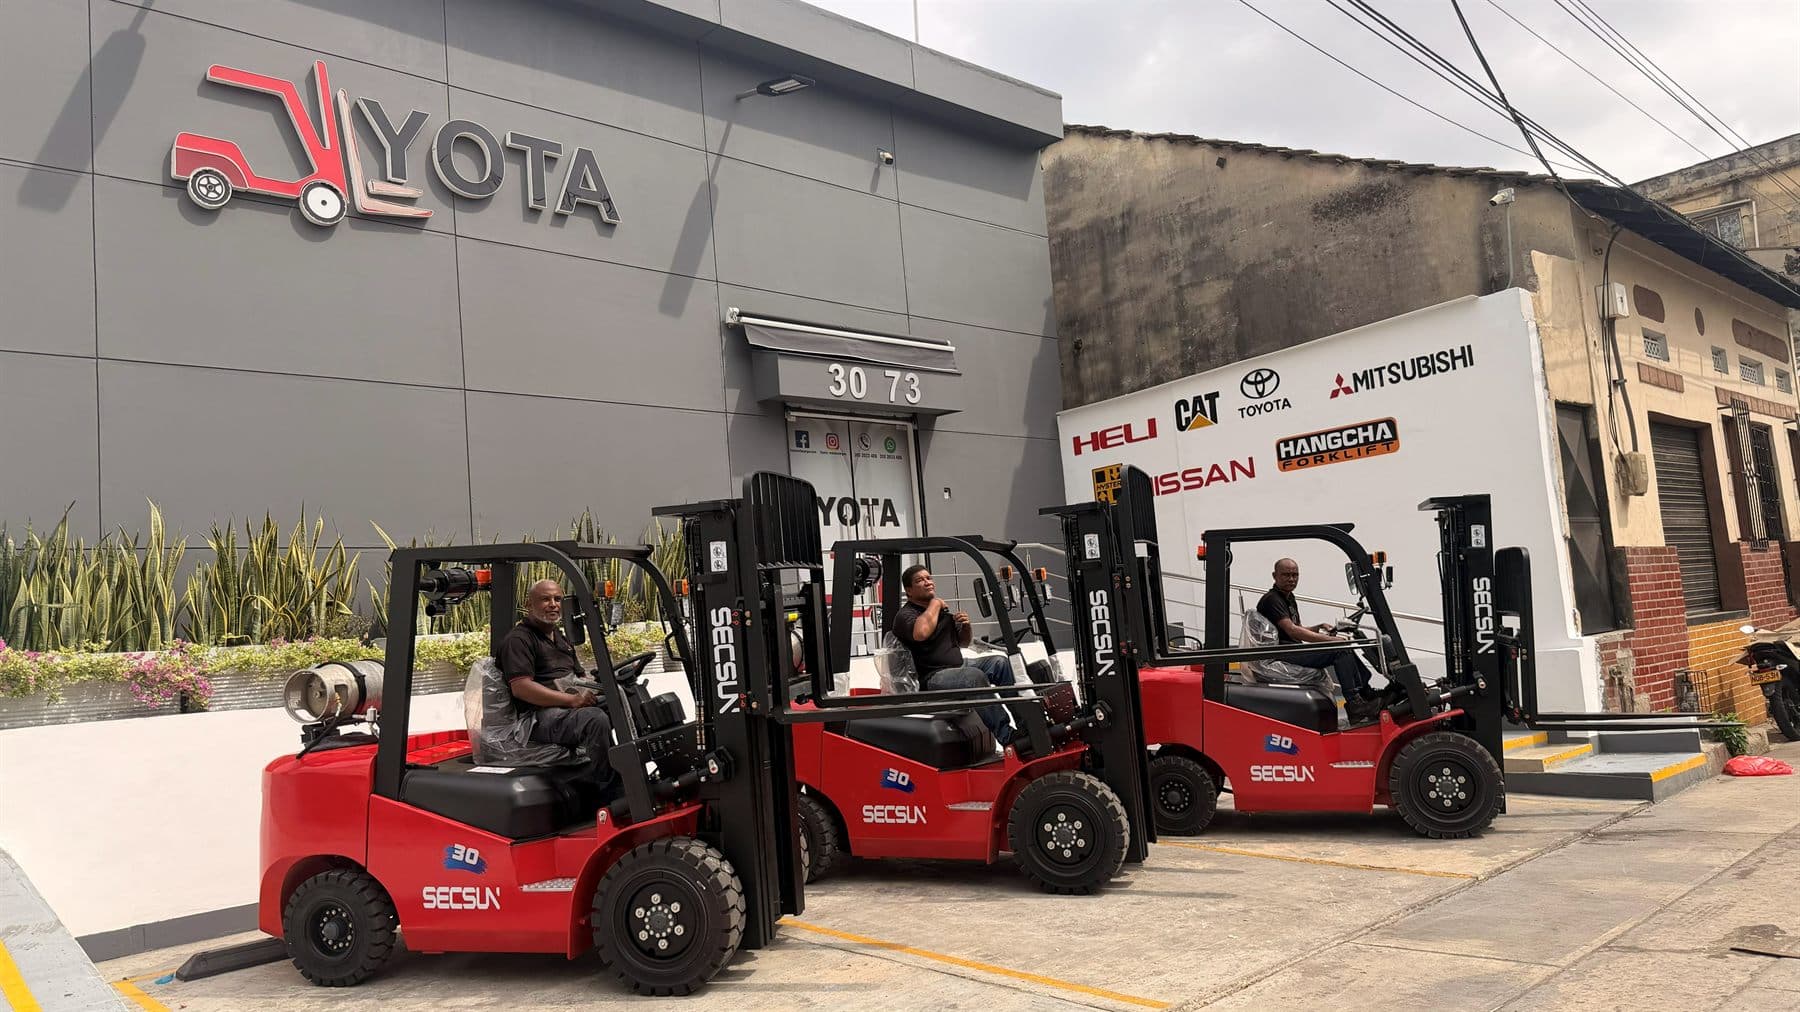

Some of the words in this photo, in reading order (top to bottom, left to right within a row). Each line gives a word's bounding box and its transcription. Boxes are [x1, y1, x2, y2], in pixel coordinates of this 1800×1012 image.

[828, 363, 867, 399] 30
[884, 370, 921, 404] 73
[1351, 344, 1475, 394] MITSUBISHI
[1174, 391, 1220, 432] CAT
[1238, 398, 1291, 419] TOYOTA
[1072, 417, 1158, 456] HELI
[1279, 422, 1393, 459] HANGCHA
[1282, 441, 1395, 470] FORKLIFT
[1150, 456, 1256, 497] ISSAN
[1089, 589, 1116, 676] SECSUN
[1472, 577, 1496, 654] SECSUN
[710, 606, 741, 714] SECSUN
[1270, 733, 1293, 749] 30
[886, 767, 910, 786] 30
[1250, 765, 1315, 782] SECSUN
[862, 804, 927, 824] SECSUN
[451, 843, 480, 865] 30
[422, 886, 501, 910] SECSUN
